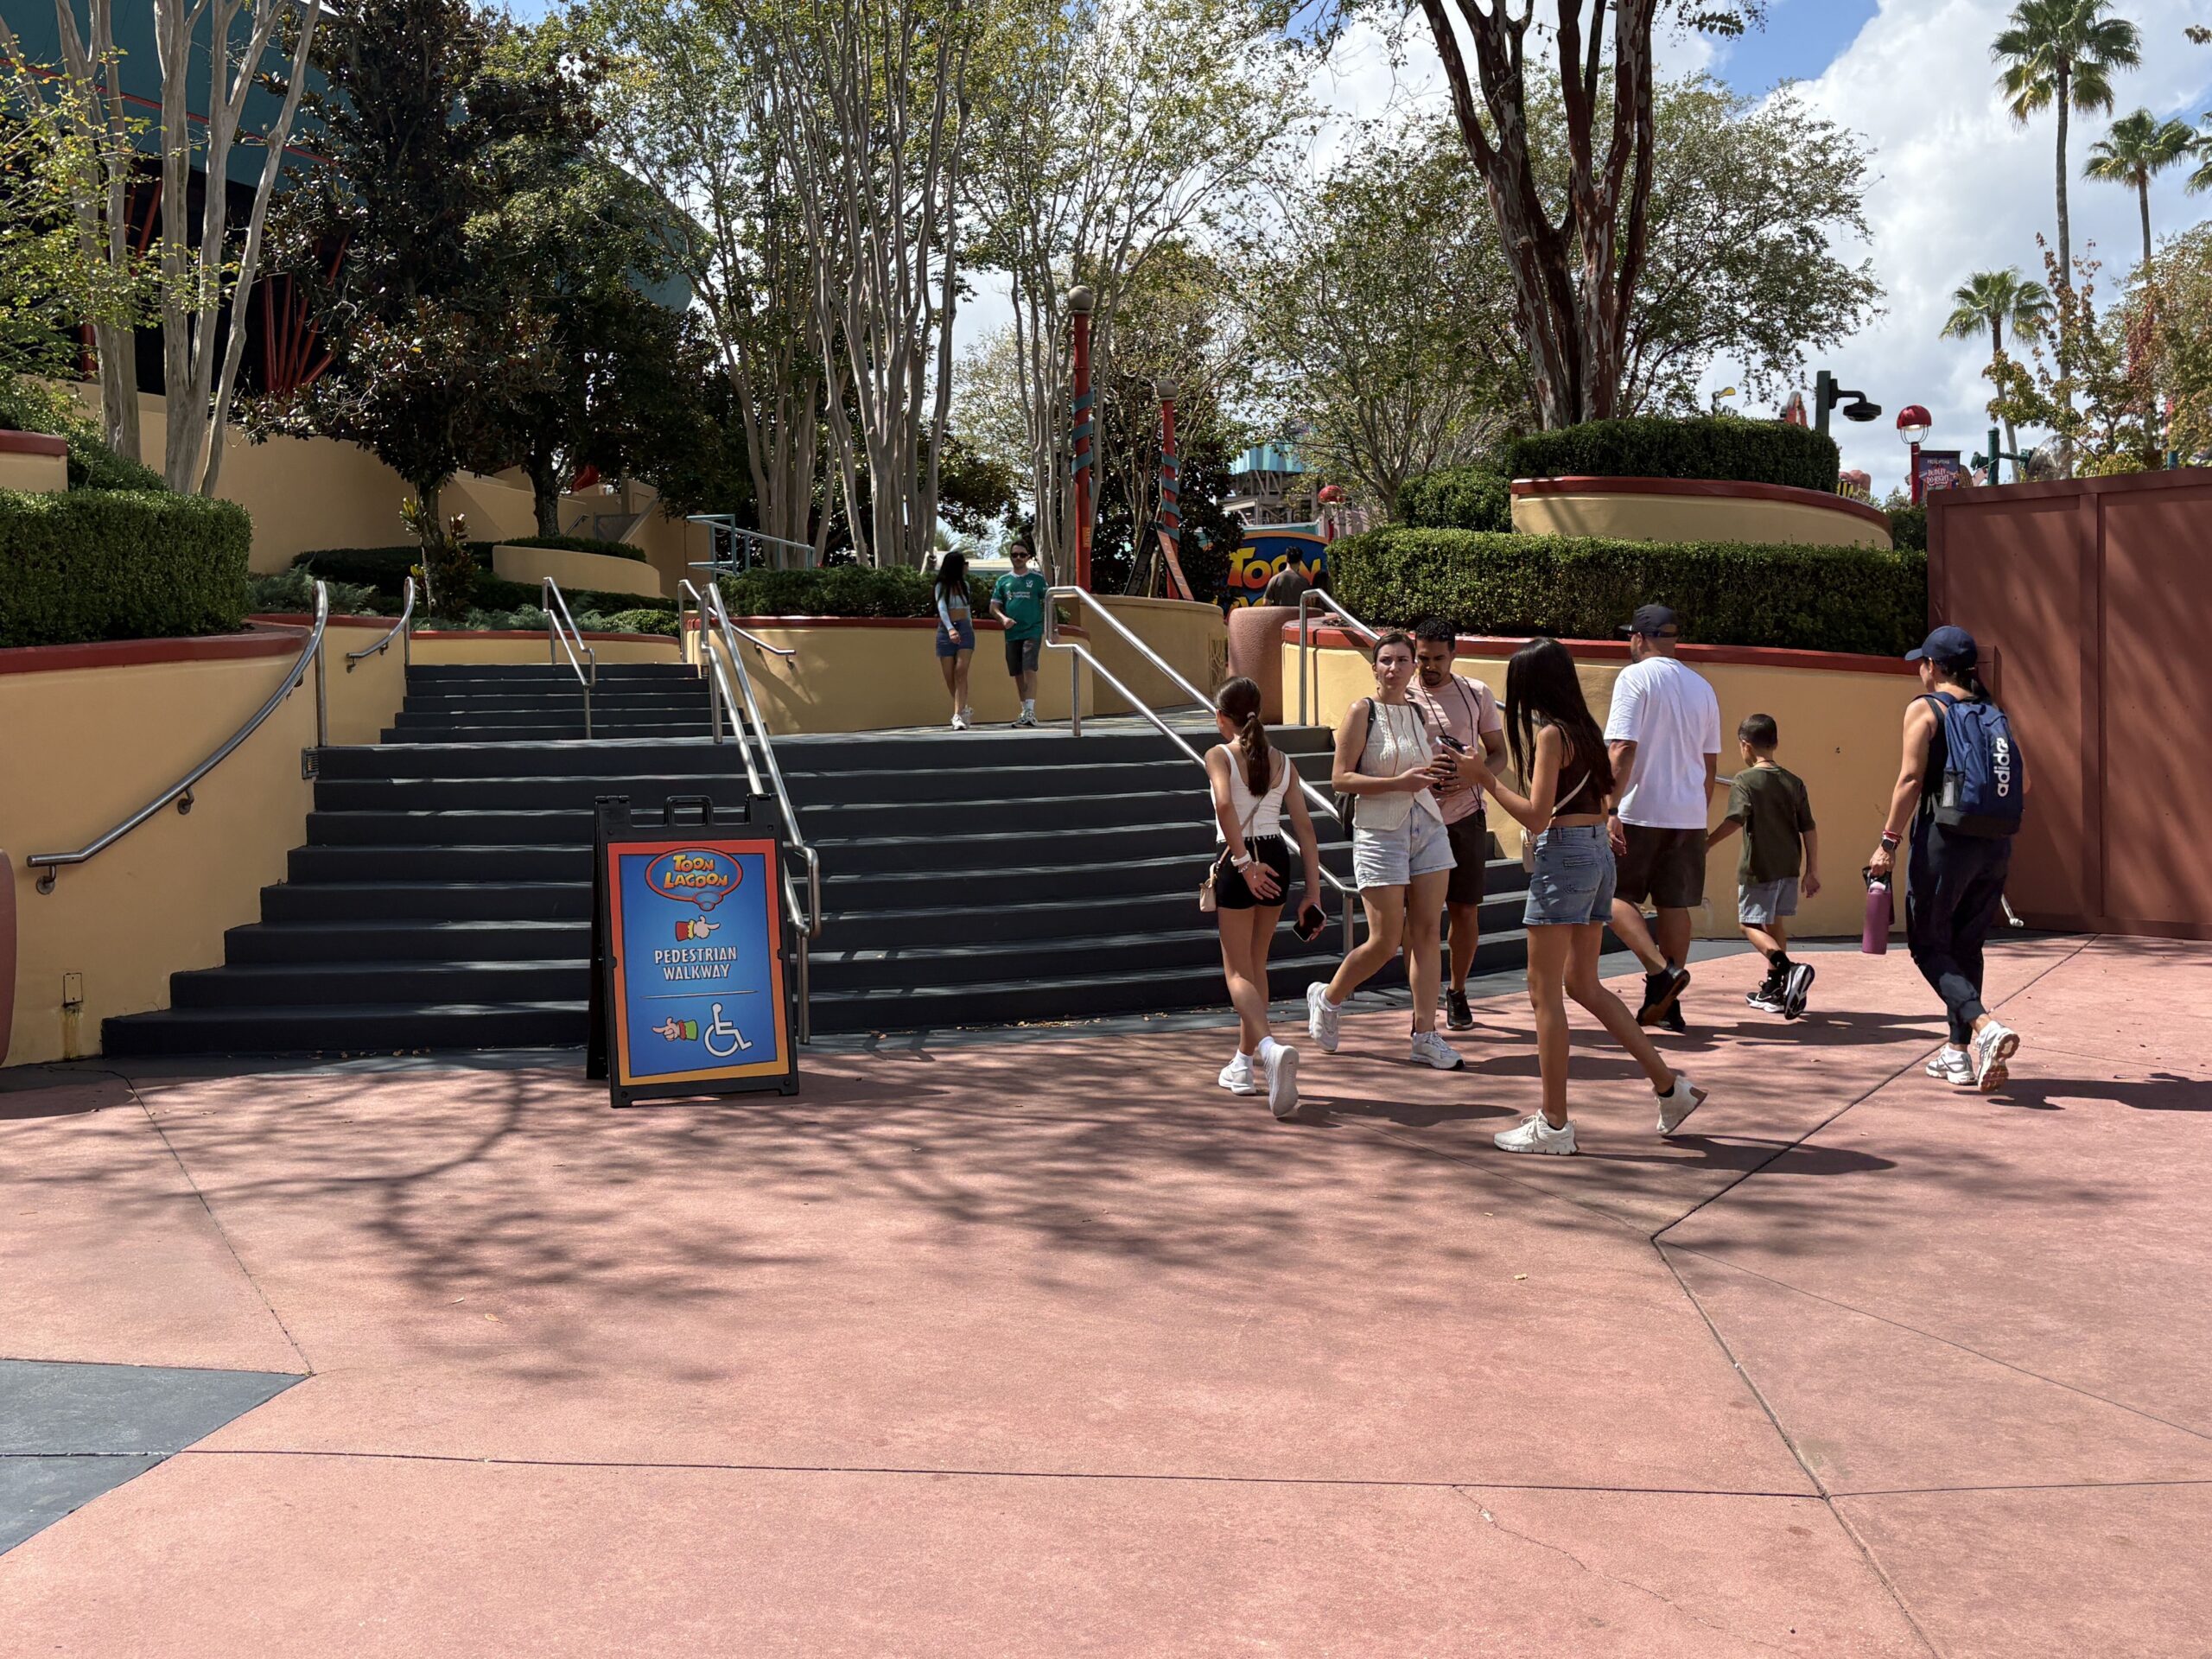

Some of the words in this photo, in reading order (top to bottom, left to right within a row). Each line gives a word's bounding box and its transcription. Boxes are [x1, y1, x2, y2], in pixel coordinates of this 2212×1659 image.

[673, 855, 715, 872] TOON
[664, 873, 728, 889] LAGOON
[655, 947, 737, 963] PEDESTRIAN
[664, 964, 729, 980] WALKWAY
